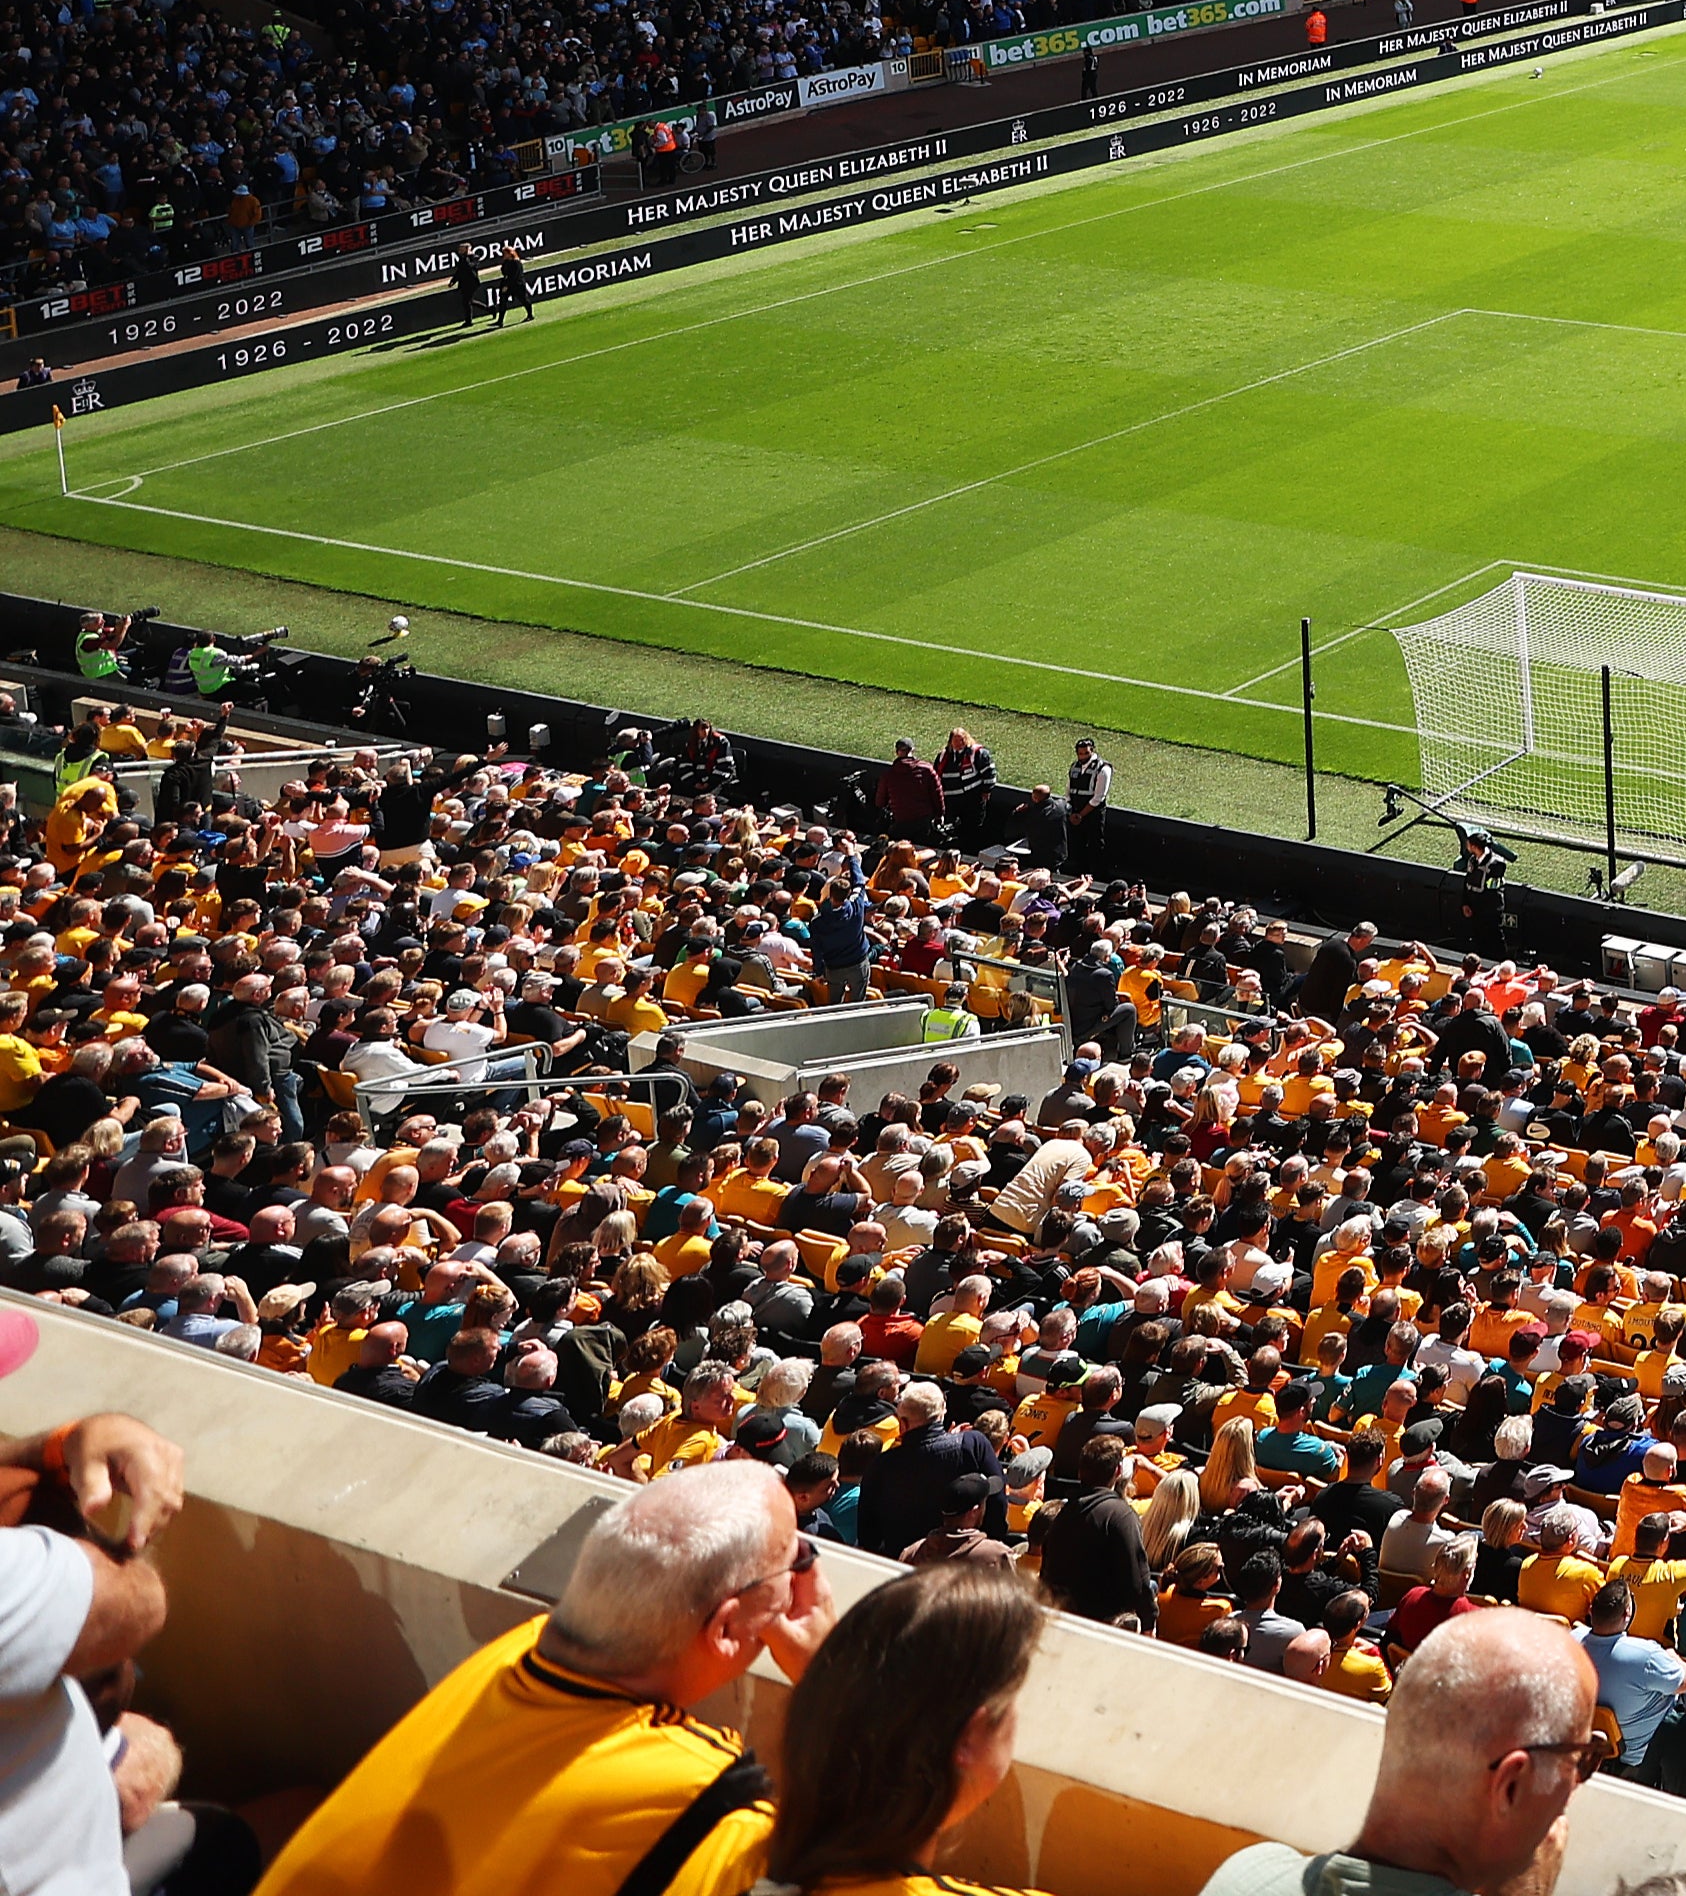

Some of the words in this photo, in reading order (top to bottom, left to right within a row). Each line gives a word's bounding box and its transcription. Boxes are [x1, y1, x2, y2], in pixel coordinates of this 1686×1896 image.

[989, 21, 1139, 66] bet365.com
[1379, 37, 1404, 54] HER
[1406, 25, 1458, 49] MAJESTY
[1461, 17, 1501, 36] QUEEN
[1503, 4, 1557, 28] ELIZABETH
[1460, 53, 1487, 69] HER
[1489, 39, 1540, 64] MAJESTY
[1542, 31, 1580, 50] QUEEN
[1584, 16, 1637, 40] ELIZABETH
[806, 70, 877, 99] AstroPay
[891, 61, 906, 74] 10
[1237, 72, 1254, 88] IN
[1257, 54, 1332, 83] MEMORIAM
[1325, 87, 1342, 102] IN
[1344, 68, 1417, 98] MEMORIAM
[724, 86, 793, 120] AstroPay
[1089, 100, 1127, 120] 1926
[1148, 87, 1186, 107] 2022
[1183, 116, 1220, 136] 1926
[1241, 103, 1277, 123] 2022
[549, 140, 563, 153] 10
[627, 202, 669, 226] HER
[675, 181, 762, 215] MAJESTY
[768, 164, 834, 194] QUEEN
[838, 144, 930, 178] ELIZABETH
[934, 139, 947, 156] II
[730, 222, 773, 246] HER
[778, 198, 866, 235] MAJESTY
[871, 183, 936, 212] QUEEN
[1036, 154, 1048, 172] II
[380, 261, 407, 284] IN
[109, 314, 177, 345] 1926
[217, 290, 284, 321] 2022
[217, 339, 287, 372] 1926
[328, 314, 395, 345] 2022
